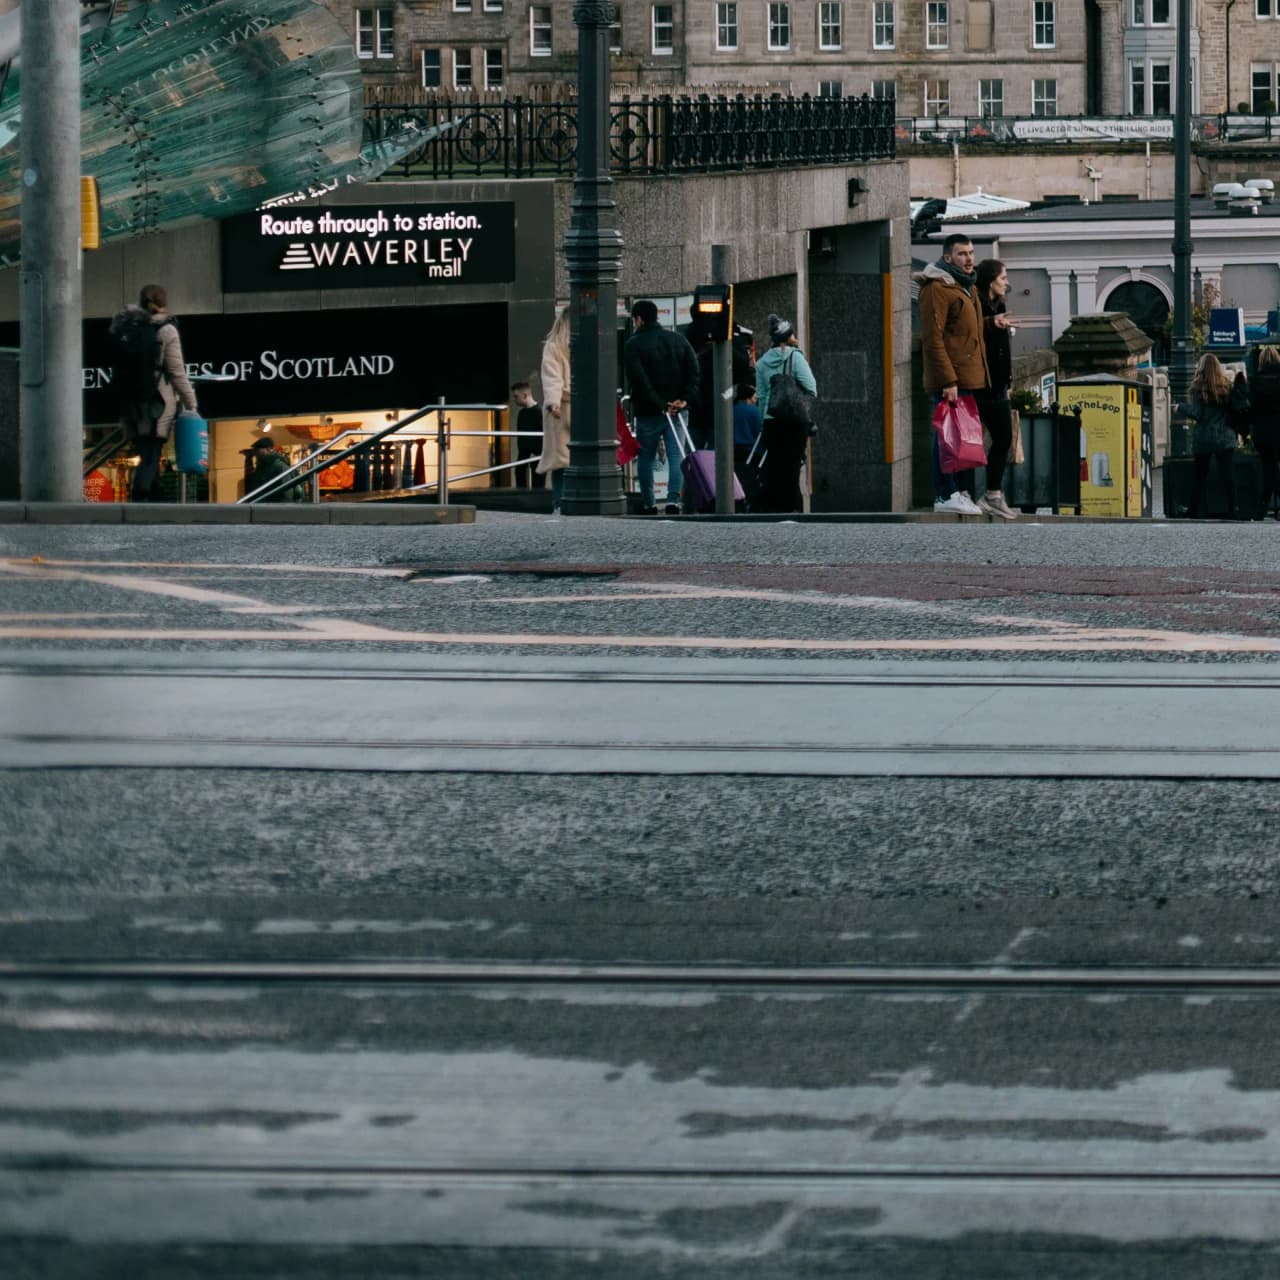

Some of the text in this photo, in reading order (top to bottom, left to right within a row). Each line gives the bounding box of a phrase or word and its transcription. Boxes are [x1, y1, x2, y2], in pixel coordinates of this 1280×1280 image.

[261, 209, 483, 238] Route through to station.
[310, 237, 473, 267] WAVERLEY
[428, 257, 462, 278] mall
[259, 350, 395, 381] SCOTLAND
